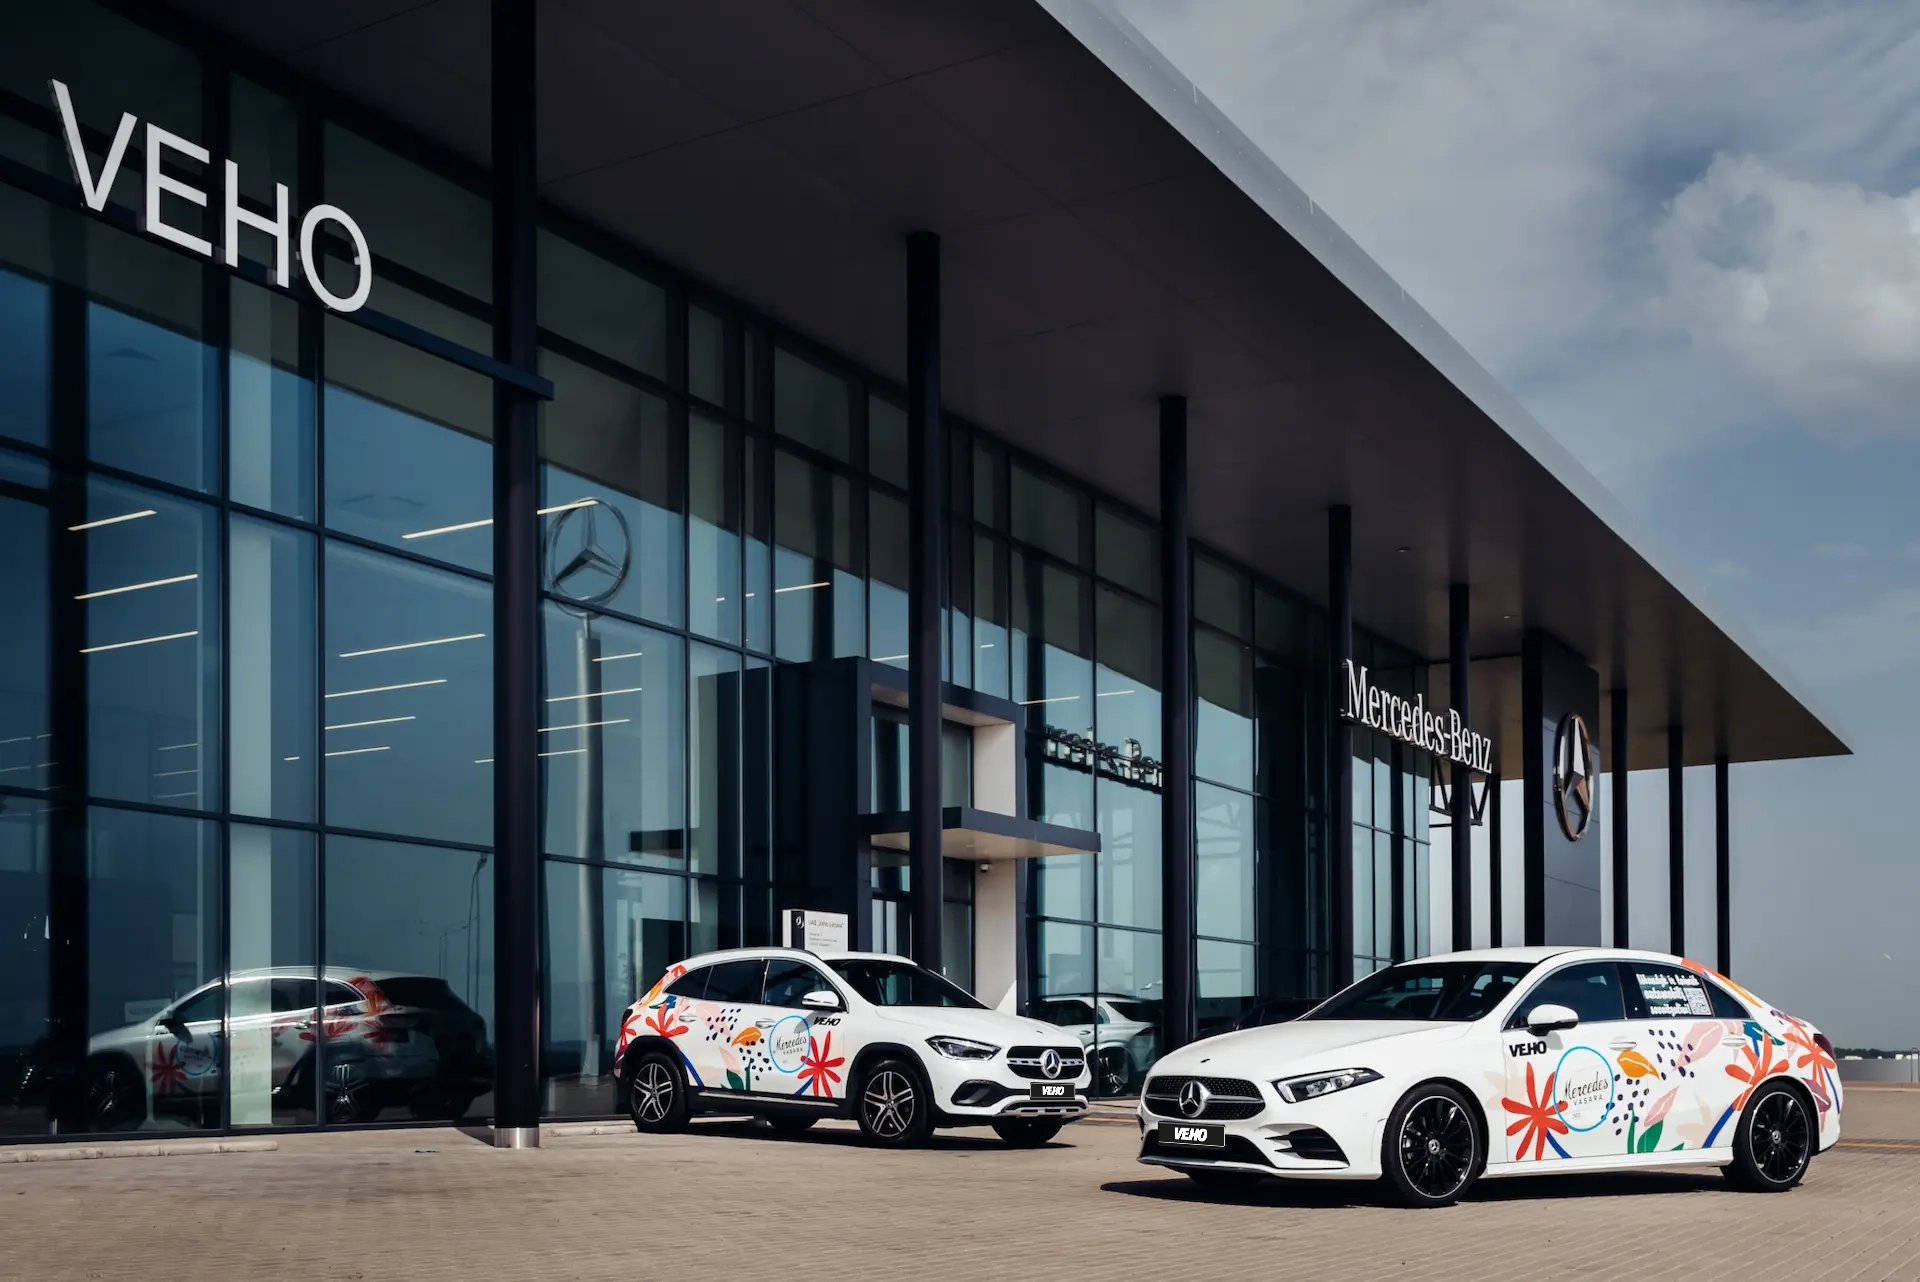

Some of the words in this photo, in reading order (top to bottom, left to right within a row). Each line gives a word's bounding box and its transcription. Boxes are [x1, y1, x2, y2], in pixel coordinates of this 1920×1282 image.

[50, 79, 372, 313] VEHO
[1346, 659, 1493, 774] Mercedes-Benz
[814, 1016, 841, 1026] VEHO
[774, 1031, 807, 1053] Mercedes
[1509, 1041, 1547, 1057] VEHO
[1042, 1086, 1065, 1096] VEHO
[1559, 1071, 1609, 1104] Mercedes
[1573, 1094, 1603, 1106] VASARA
[1174, 1127, 1208, 1142] VEHO
